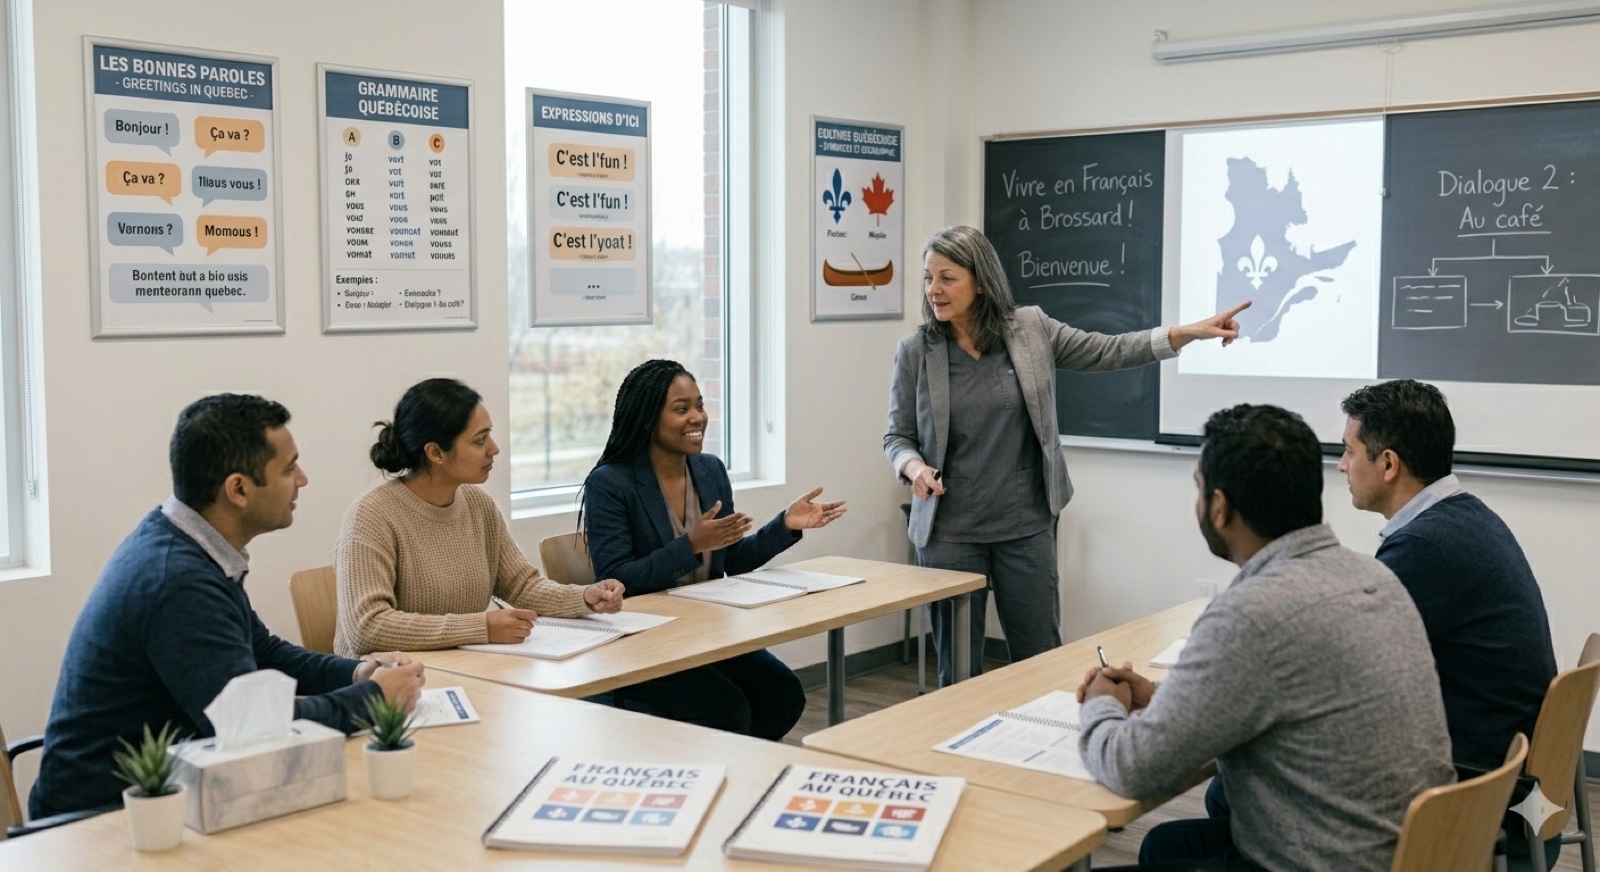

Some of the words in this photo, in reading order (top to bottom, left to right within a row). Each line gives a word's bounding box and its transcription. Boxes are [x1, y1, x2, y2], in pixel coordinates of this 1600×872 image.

[100, 55, 128, 71] LES
[133, 59, 197, 79] BONNES
[200, 66, 266, 86] PAROLES
[122, 77, 186, 94] GREETINGS
[190, 84, 201, 95] IN
[204, 85, 248, 99] QUEBEC
[358, 81, 439, 102] GRAMMAIRE
[542, 106, 613, 125] EXPRESSIONS
[616, 113, 639, 127] D'ICI
[115, 120, 161, 135] Bonjour
[210, 127, 225, 141] Ça
[227, 130, 240, 140] va
[244, 129, 249, 141] ?
[348, 132, 356, 142] A
[393, 135, 400, 145] B
[433, 138, 440, 148] C
[557, 150, 589, 167] C'est
[592, 152, 619, 169] l'fun
[624, 154, 627, 169] !
[123, 171, 138, 186] Ça
[142, 174, 155, 184] va
[159, 173, 165, 184] ?
[230, 179, 254, 190] vous
[1002, 169, 1046, 198] Vivre
[1054, 178, 1075, 194] en
[1083, 163, 1153, 195] Français
[1438, 169, 1531, 207] Dialogue
[1542, 164, 1559, 190] 2
[557, 191, 589, 208] C'est
[593, 193, 620, 209] l'fun
[624, 194, 627, 209] !
[1018, 209, 1030, 230] à
[1040, 203, 1122, 230] Brossard
[1128, 200, 1133, 227] !
[1459, 206, 1485, 230] Au
[1496, 203, 1544, 229] café
[167, 224, 173, 235] ?
[205, 225, 251, 237] Momous
[553, 232, 586, 248] C'est
[590, 234, 624, 252] l'yoat
[628, 234, 632, 249] !
[1017, 251, 1113, 278] Bienvenue
[1120, 242, 1125, 275] !
[132, 270, 176, 281] Bontent
[200, 272, 206, 281] a
[208, 270, 225, 281] bio
[227, 271, 248, 281] usis
[136, 286, 201, 296] menteorann
[205, 286, 246, 299] quebec.
[564, 774, 598, 785] AU
[573, 763, 701, 780] FRANÇAIS
[800, 783, 832, 794] AU
[808, 771, 939, 792] FRANÇAIS
